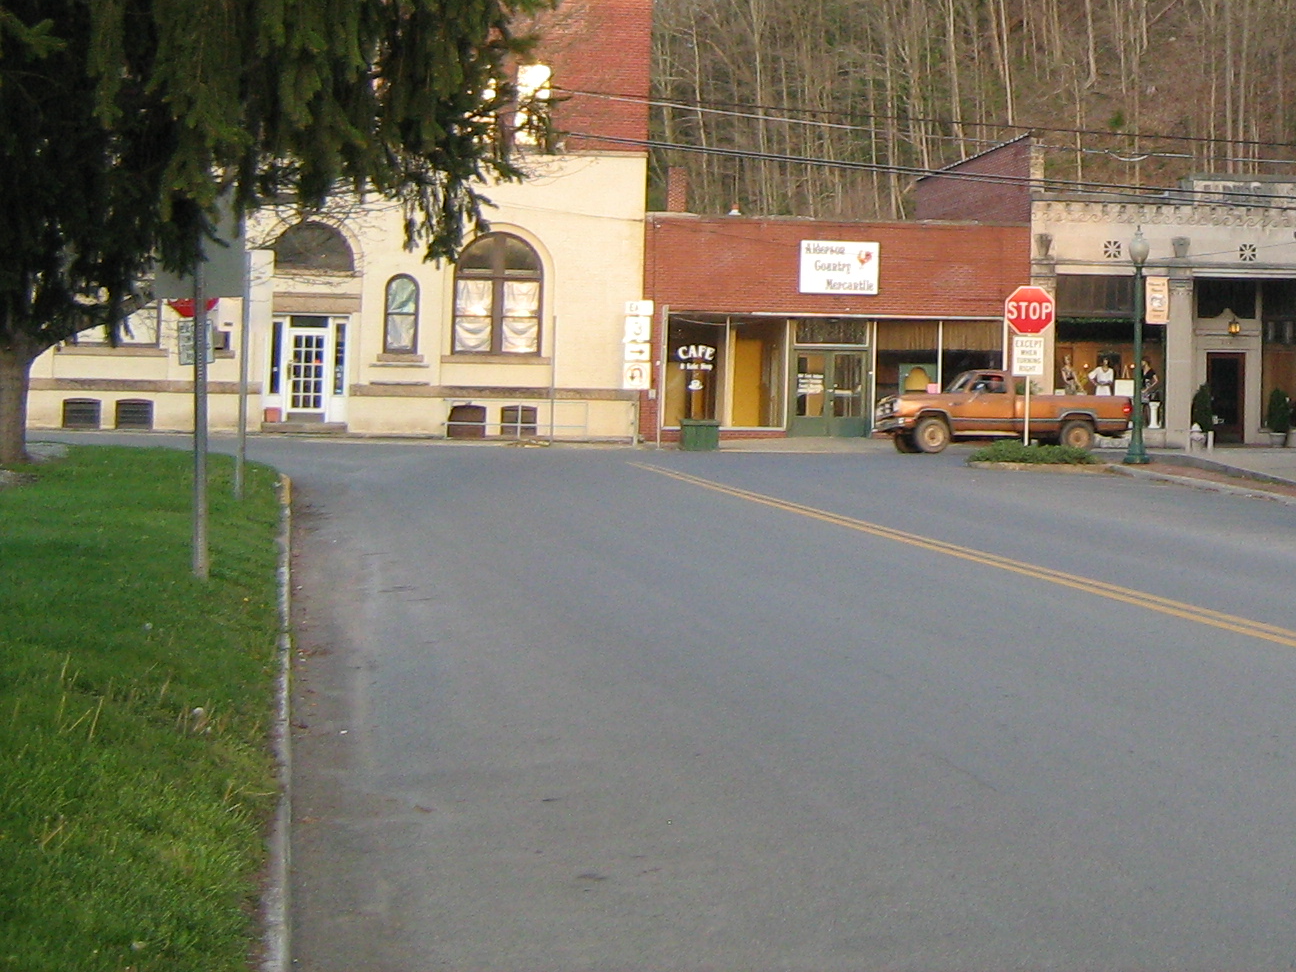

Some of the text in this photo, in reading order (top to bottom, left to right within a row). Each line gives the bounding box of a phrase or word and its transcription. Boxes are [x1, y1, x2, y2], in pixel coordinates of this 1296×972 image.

[805, 243, 845, 255] Alderson
[825, 279, 874, 291] Mercantile
[1007, 301, 1052, 320] STOP
[1015, 340, 1042, 348] EXCEPT
[678, 344, 716, 361] CAFE
